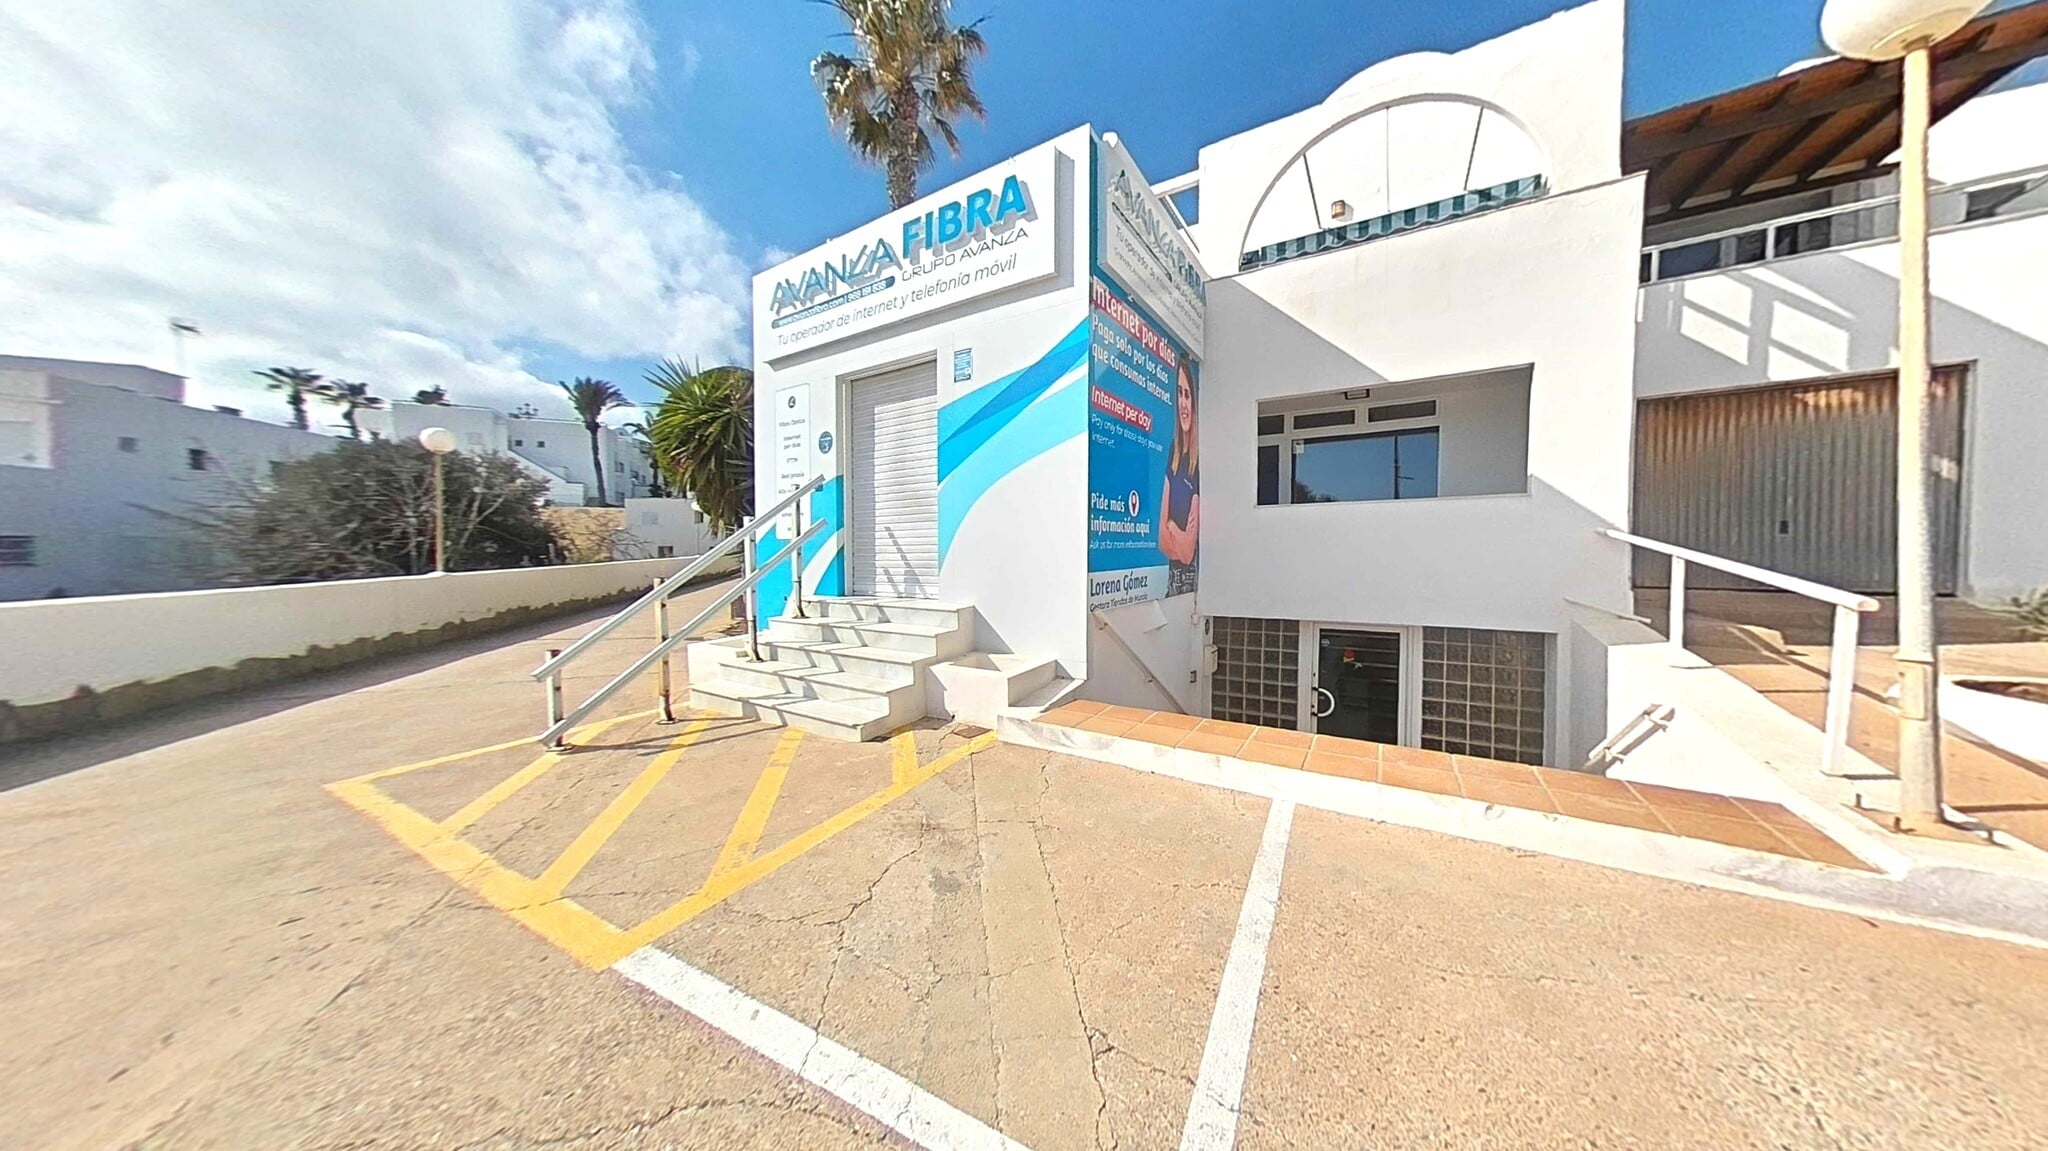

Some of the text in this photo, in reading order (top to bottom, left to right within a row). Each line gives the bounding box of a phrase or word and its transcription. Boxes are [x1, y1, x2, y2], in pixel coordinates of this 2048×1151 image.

[770, 174, 1030, 316] AVANZA FIBRA
[902, 228, 1029, 281] GRUPO AVANZA
[778, 252, 1017, 345] Tu operador de internet y telefonía móvil
[1093, 277, 1140, 338] Internet
[1142, 324, 1158, 352] por
[1159, 337, 1176, 368] días
[1092, 314, 1169, 385] Paga solo por los días
[1092, 343, 1109, 363] que
[1109, 355, 1146, 388] consumas
[1092, 385, 1152, 431] Internet per day
[1092, 413, 1103, 429] Pay
[1103, 421, 1116, 435] only
[1091, 491, 1125, 513] Pide más
[1090, 539, 1099, 549] Ask
[1091, 515, 1150, 537] información aquí
[1090, 577, 1121, 597] Lorena
[1123, 570, 1148, 595] Gómez
